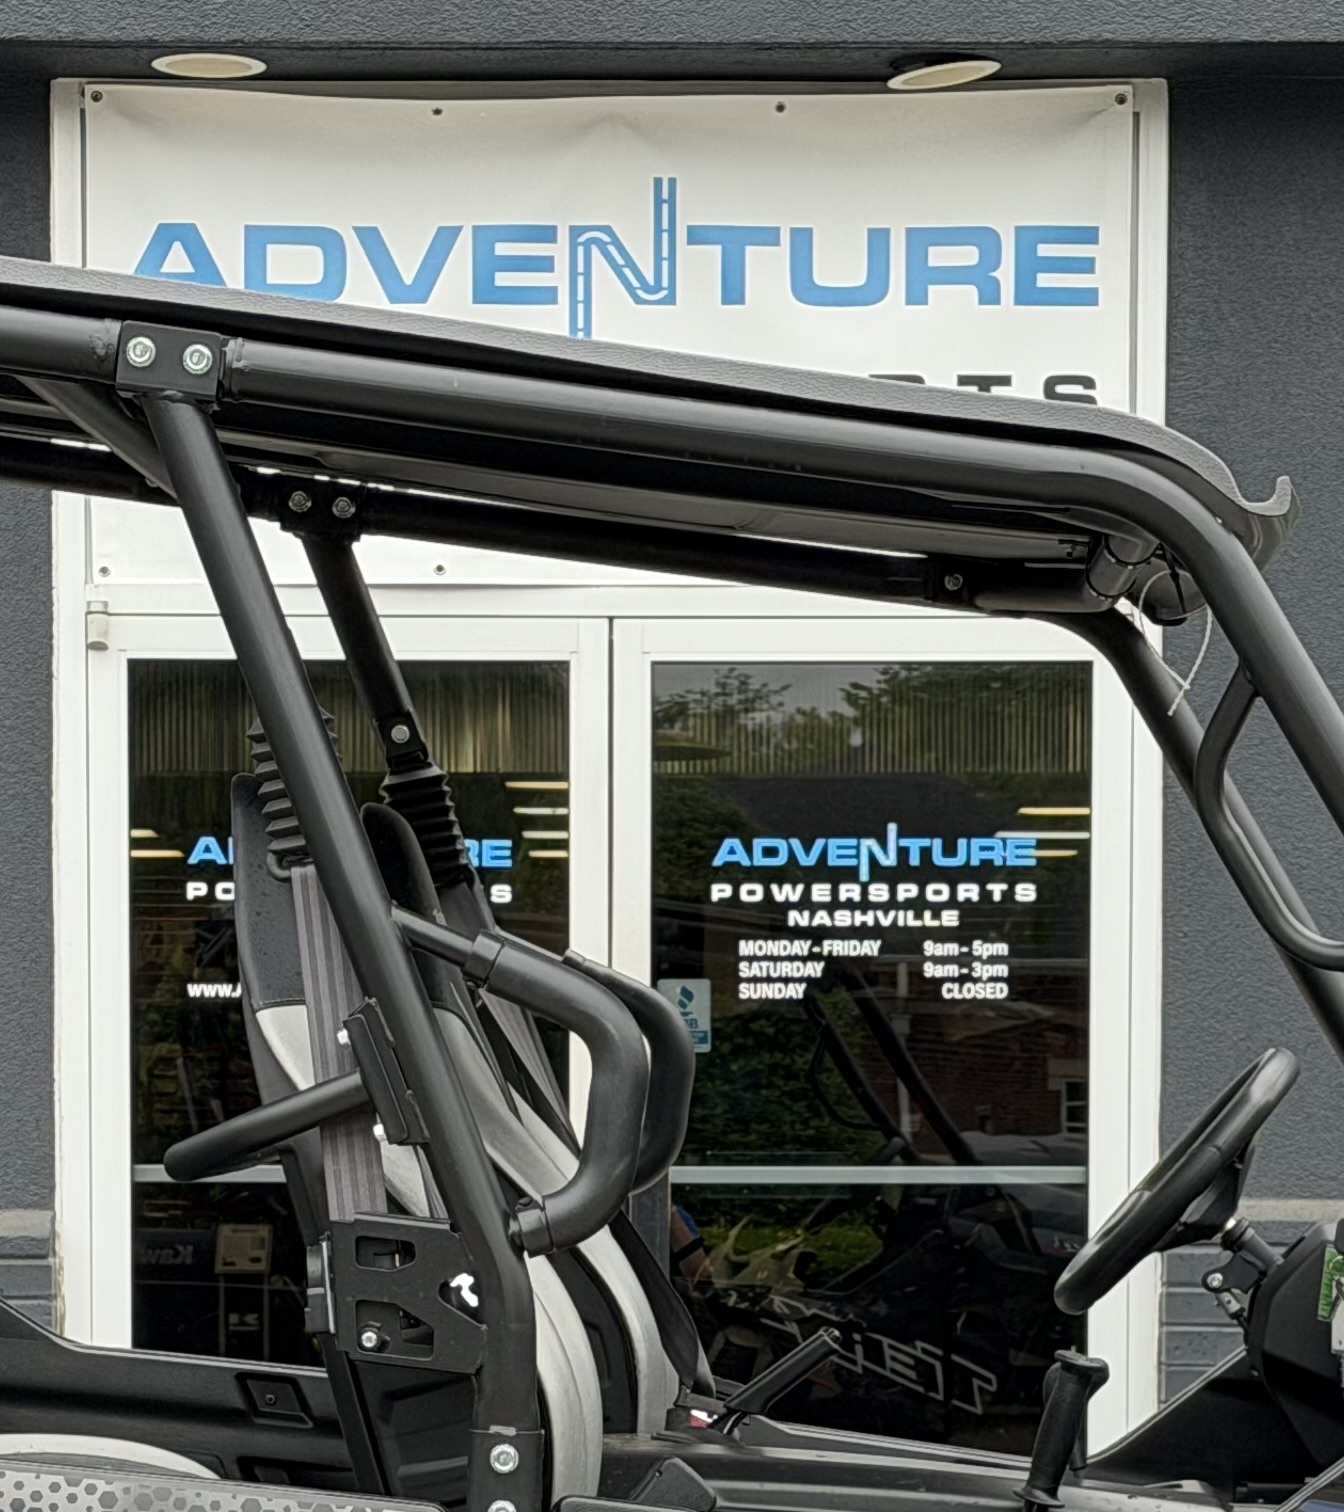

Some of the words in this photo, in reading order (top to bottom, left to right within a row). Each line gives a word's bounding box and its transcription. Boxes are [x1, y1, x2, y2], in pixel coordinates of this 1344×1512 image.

[131, 177, 1100, 340] ADVENTURE
[712, 822, 1038, 882] ADVENTURE
[711, 883, 1037, 903] POWERSPORTS
[787, 909, 960, 927] NASHVILLE
[738, 961, 825, 978] SATURDAY
[738, 982, 807, 1000] SUNDAY
[941, 982, 1009, 1000] CLOSED
